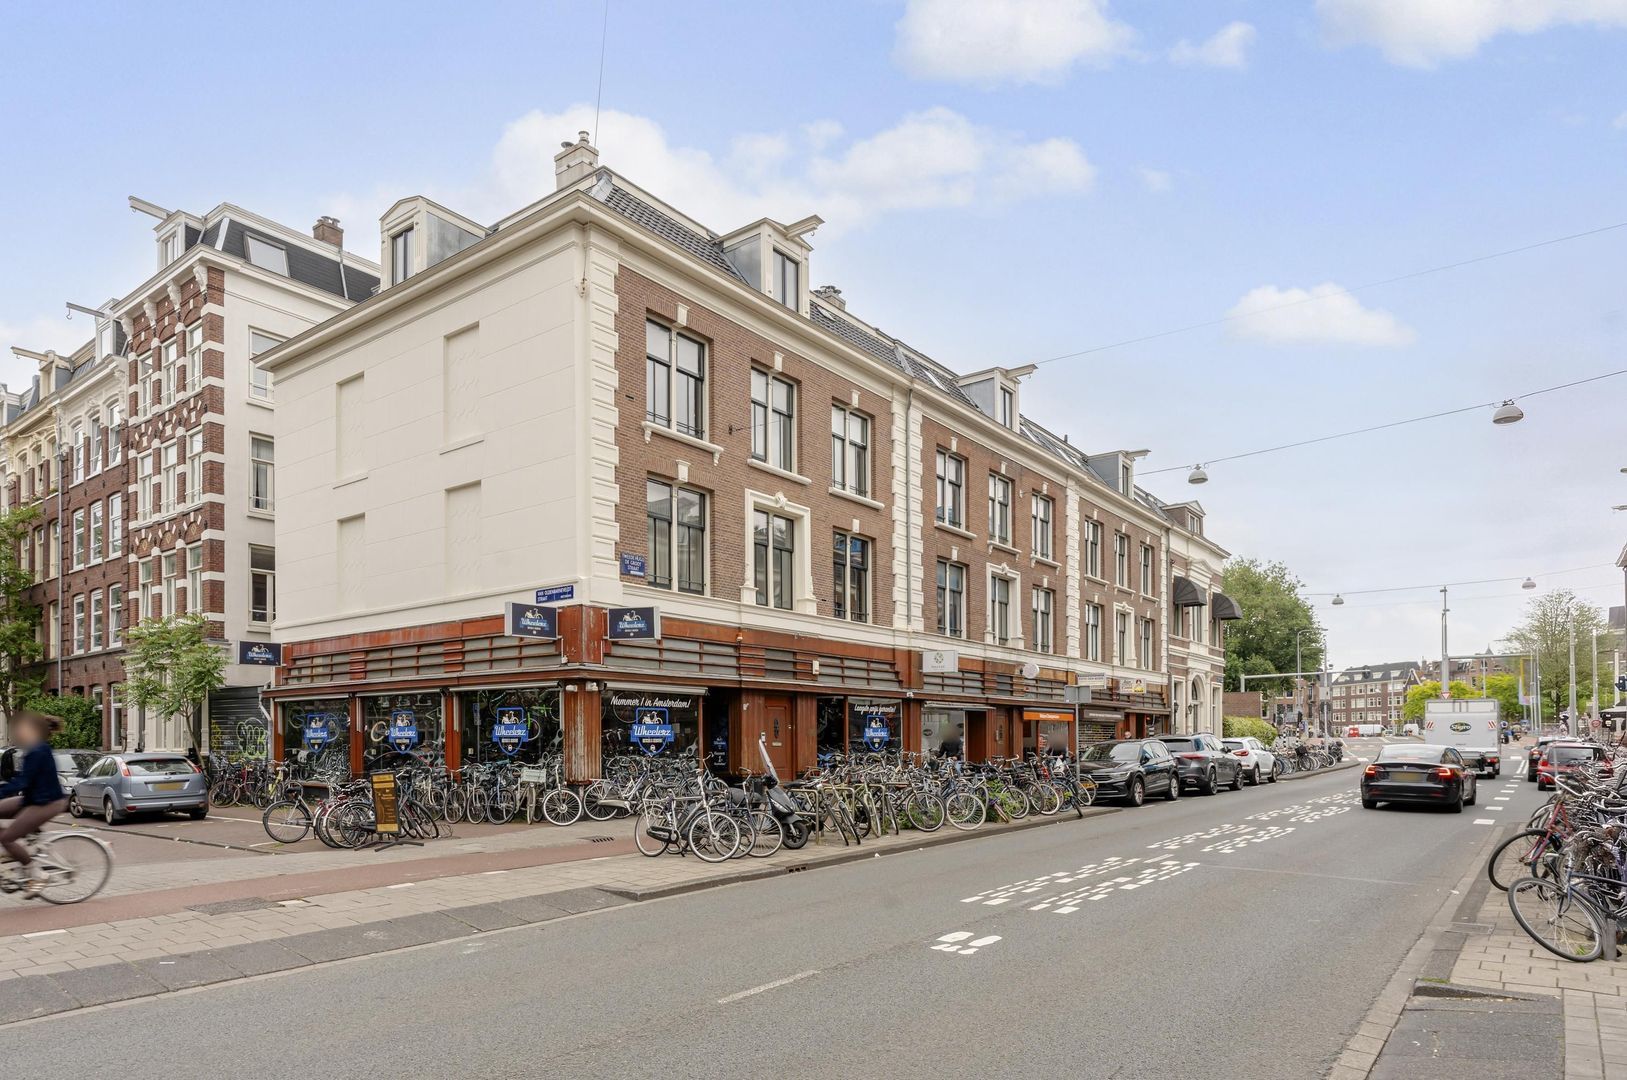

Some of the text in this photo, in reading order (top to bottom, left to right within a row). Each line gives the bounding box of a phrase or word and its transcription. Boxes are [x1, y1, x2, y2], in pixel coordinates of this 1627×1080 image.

[610, 696, 640, 707] Nummer
[645, 698, 652, 707] in
[653, 697, 692, 709] Amsterdam!
[494, 725, 526, 736] Wheelerz
[632, 725, 672, 736] Wheelerz
